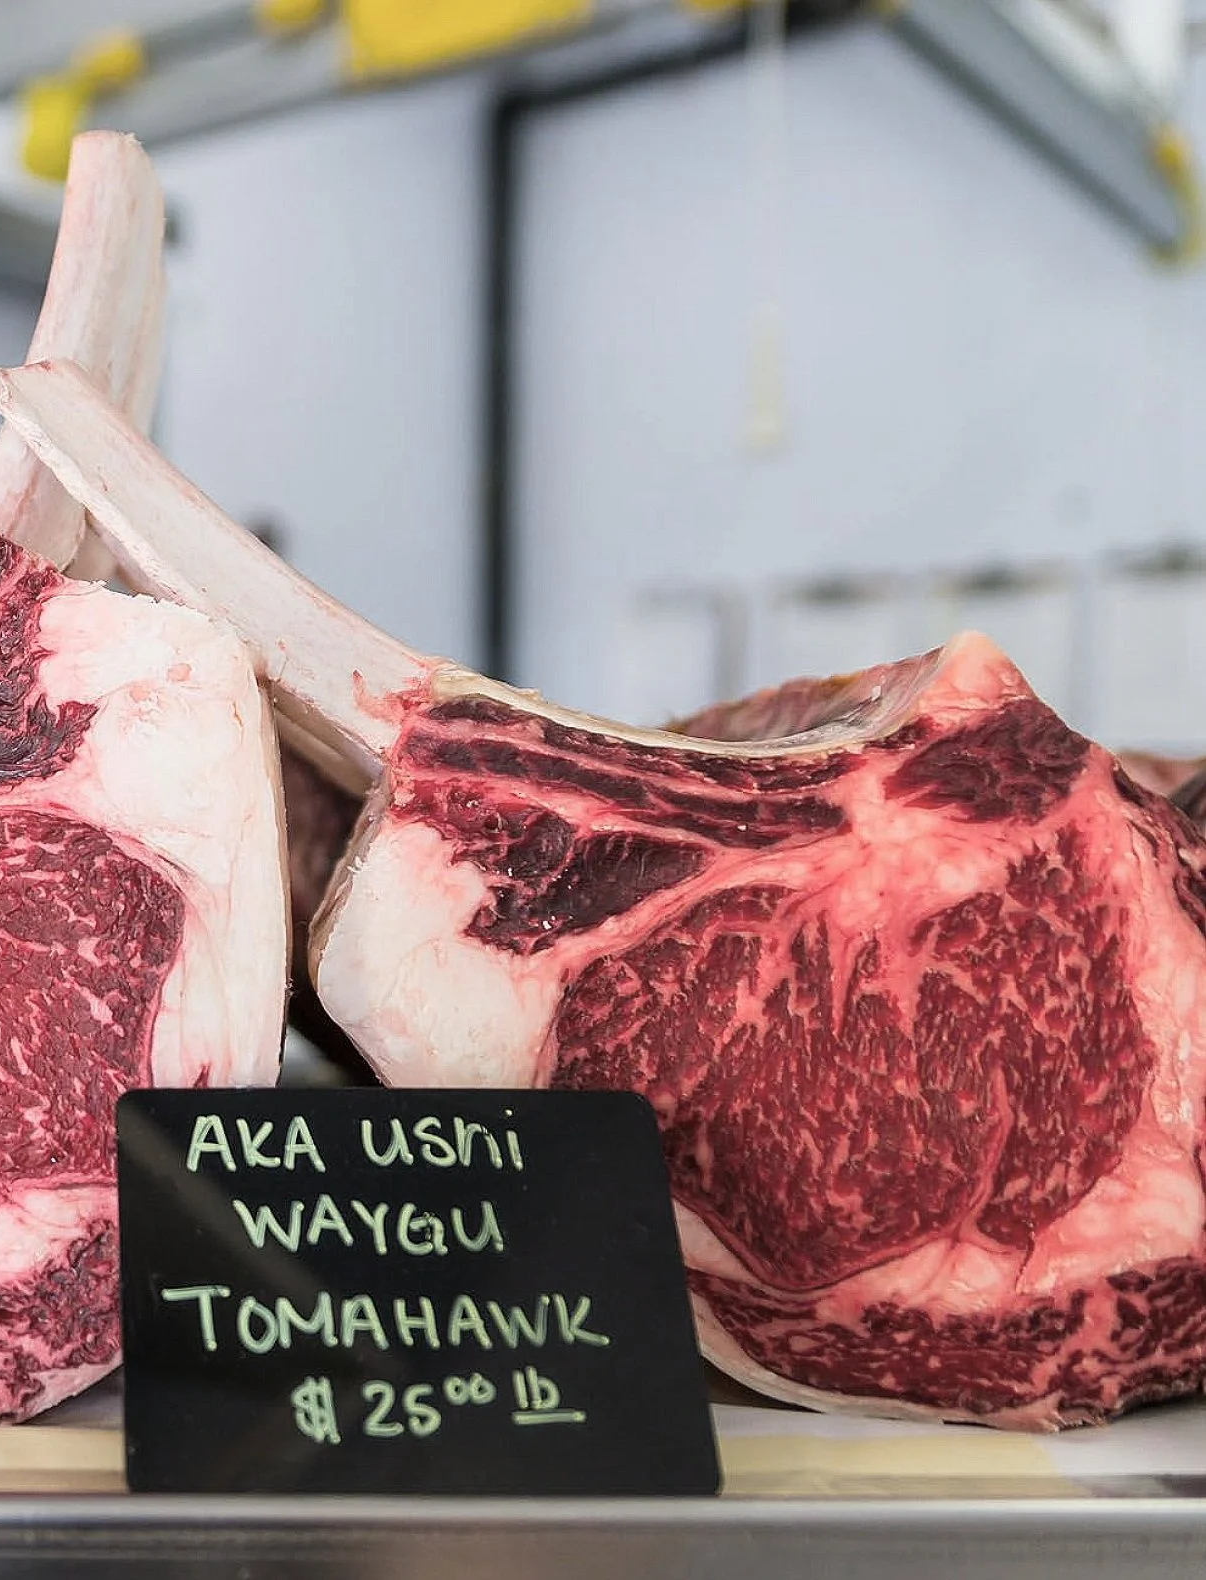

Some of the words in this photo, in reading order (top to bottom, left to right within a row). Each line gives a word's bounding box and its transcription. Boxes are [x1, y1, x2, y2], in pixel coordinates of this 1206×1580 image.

[186, 1115, 327, 1173] AKA
[232, 1194, 504, 1255] WAYGU
[161, 1285, 610, 1353] TOMAHAWK
[291, 1377, 342, 1444] $
[513, 1365, 586, 1425] lb
